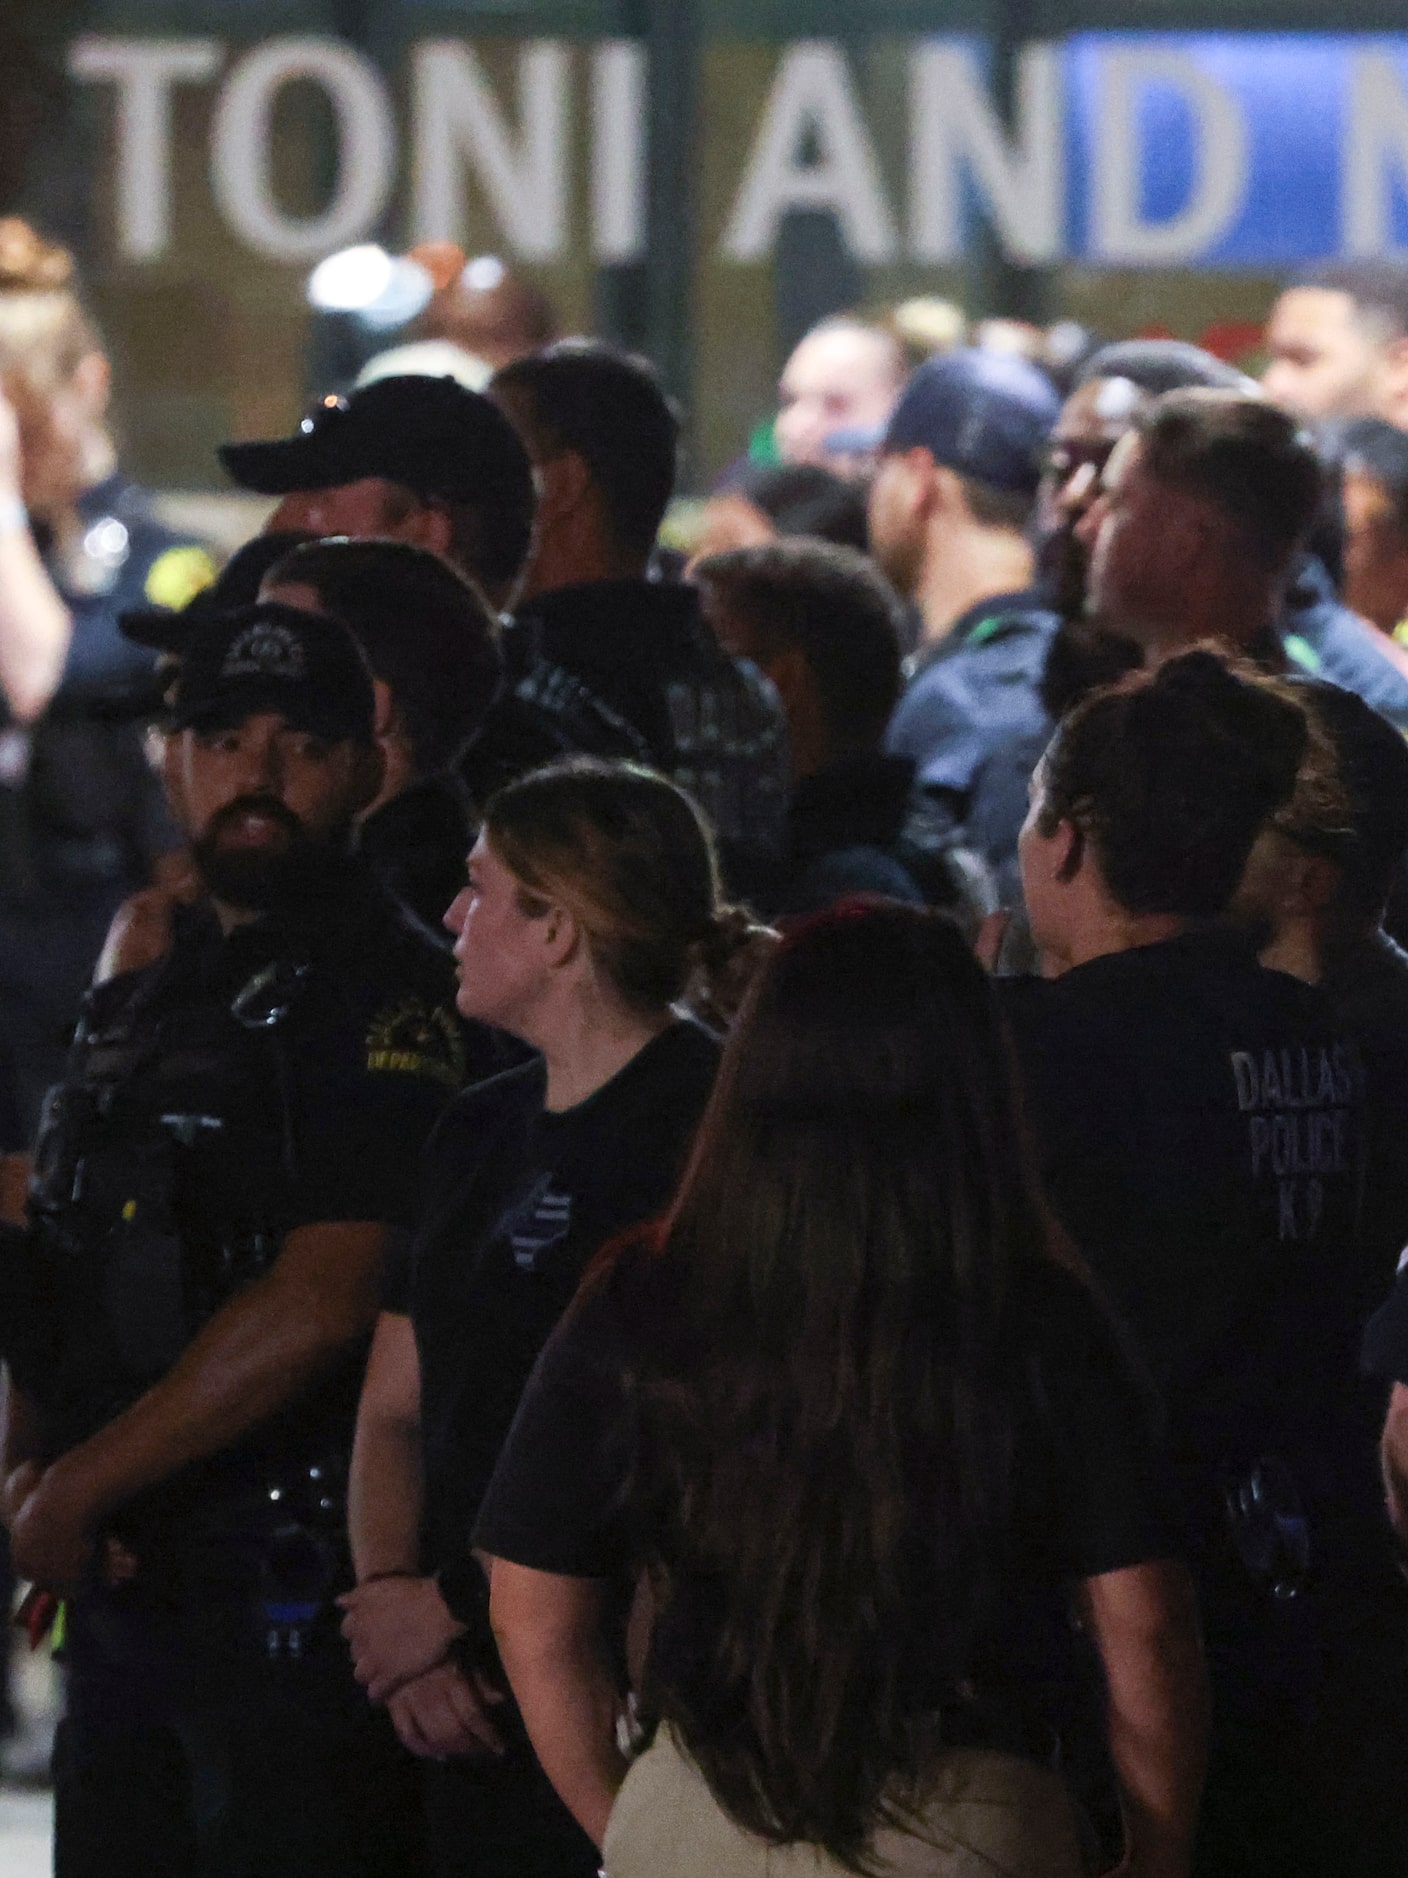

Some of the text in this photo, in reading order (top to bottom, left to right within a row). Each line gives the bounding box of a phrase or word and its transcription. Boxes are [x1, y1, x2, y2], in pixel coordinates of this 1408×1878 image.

[67, 34, 649, 264] TONI
[722, 38, 1250, 266] AND
[1230, 1043, 1352, 1111] DALLAS
